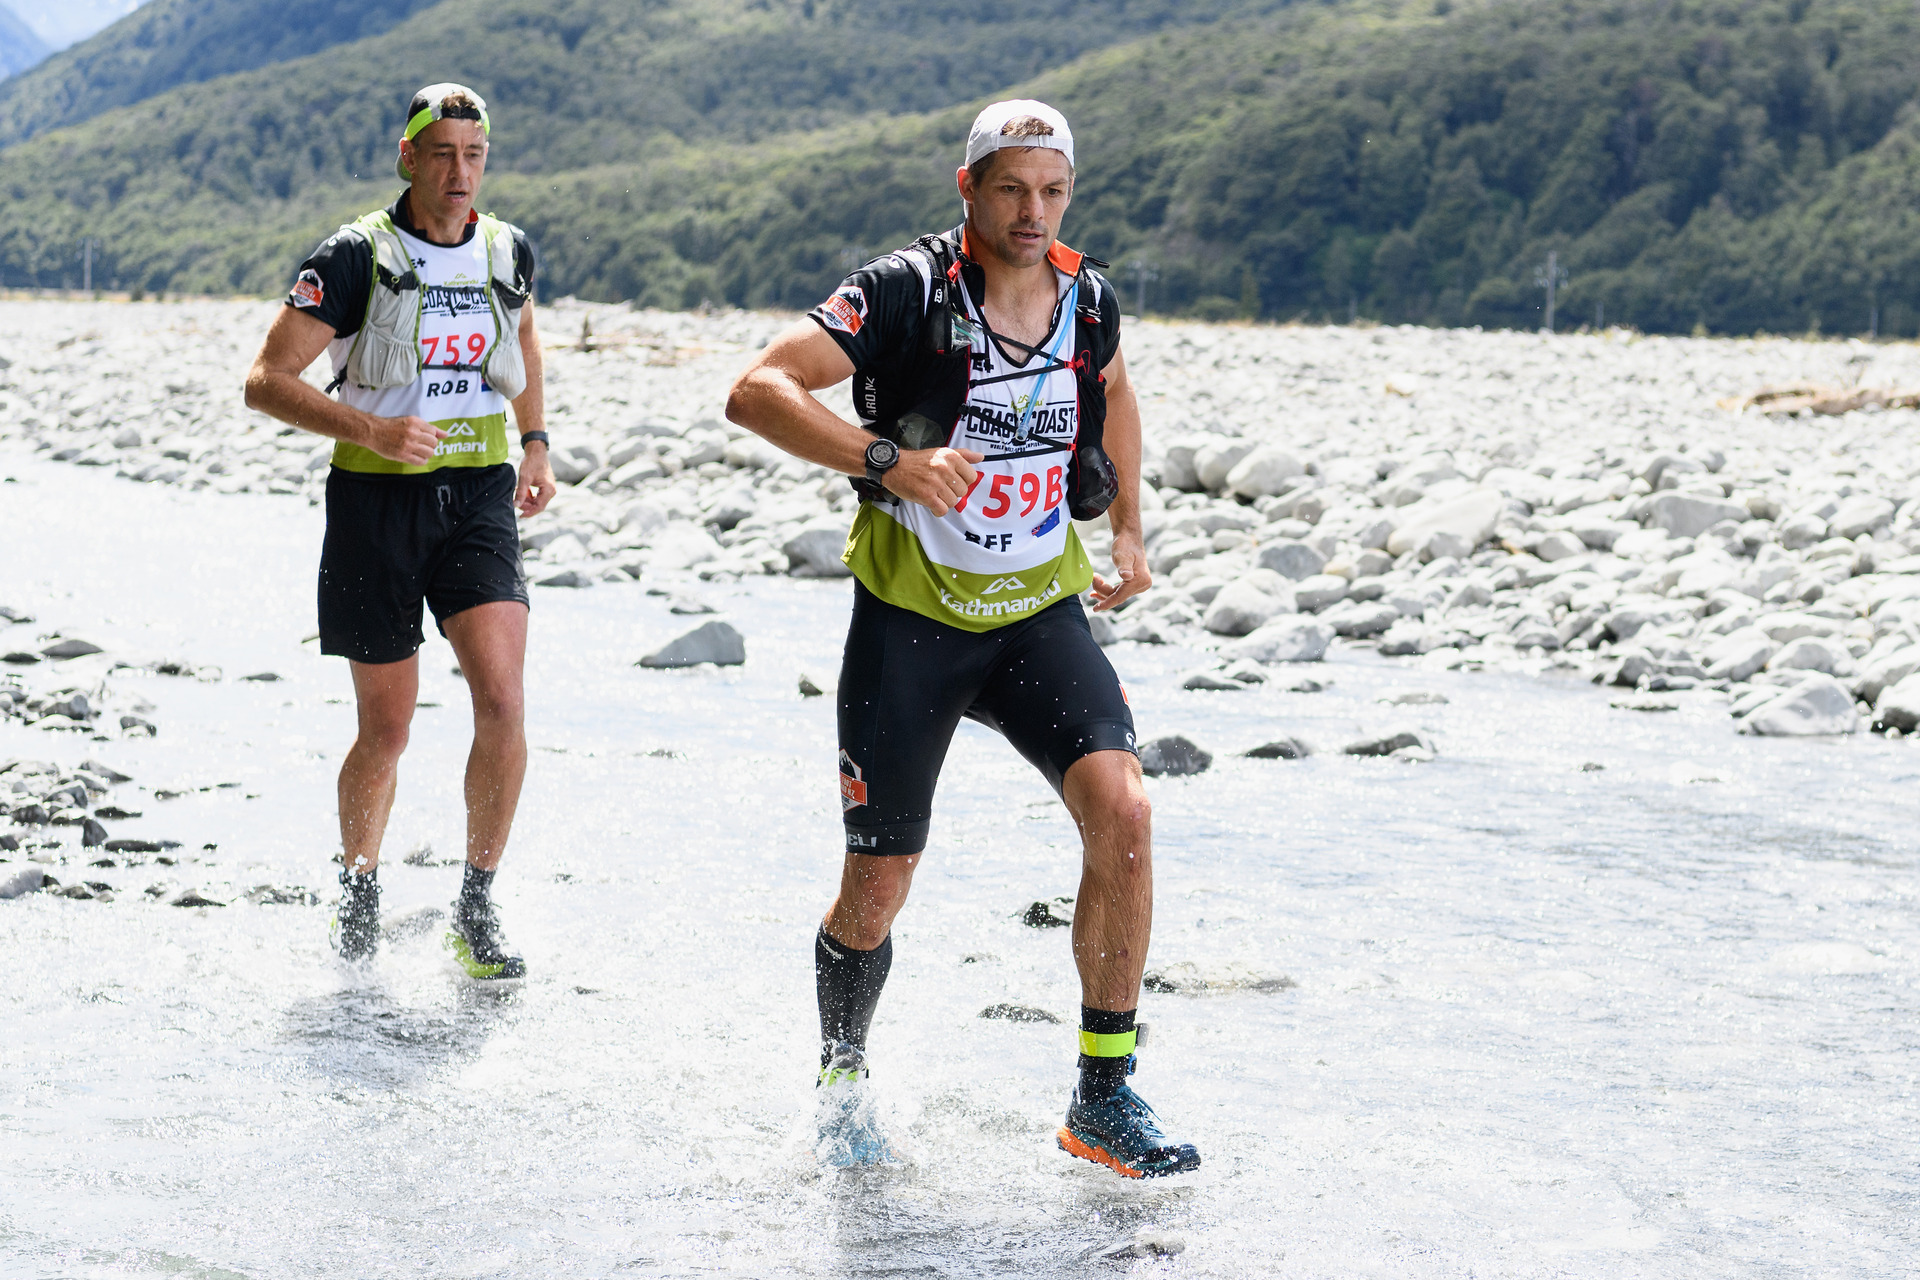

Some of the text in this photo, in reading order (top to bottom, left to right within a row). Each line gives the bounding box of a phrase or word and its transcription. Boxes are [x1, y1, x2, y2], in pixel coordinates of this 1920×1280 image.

[421, 333, 486, 366] 759
[426, 380, 469, 398] ROB
[954, 465, 1063, 519] 759B
[940, 578, 1062, 617] Kathmandu
